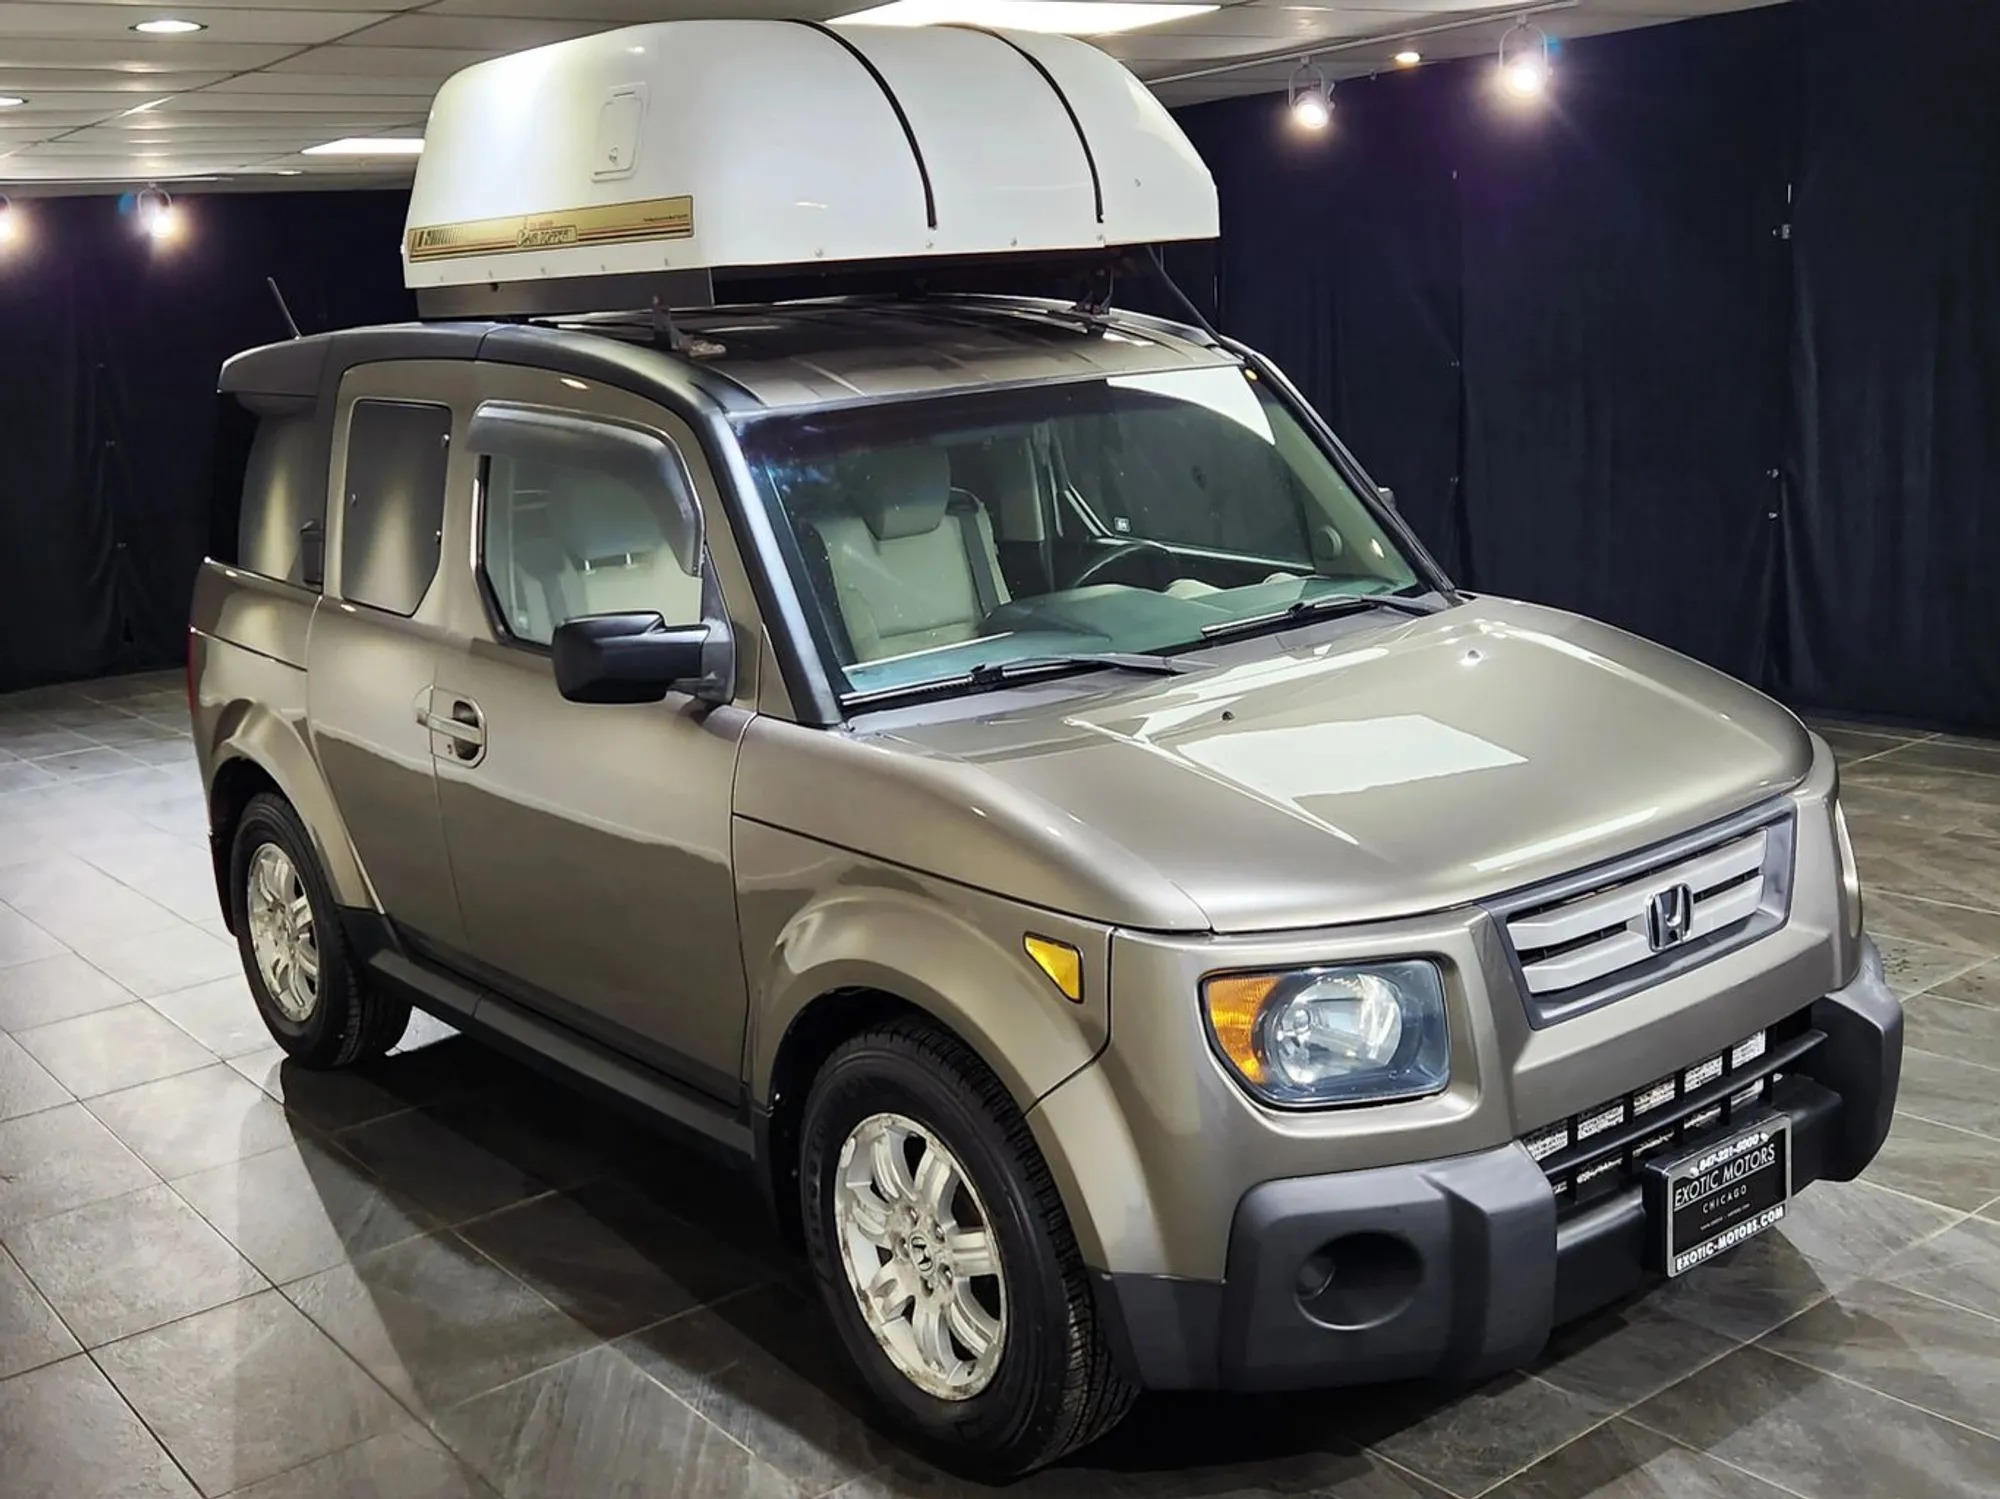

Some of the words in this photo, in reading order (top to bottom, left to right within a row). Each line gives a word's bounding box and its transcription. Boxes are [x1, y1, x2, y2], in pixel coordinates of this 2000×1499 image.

[1675, 1169, 1719, 1207] EXOTIC
[1722, 1143, 1775, 1183] MOTORS
[1702, 1184, 1747, 1213] CHICAGO
